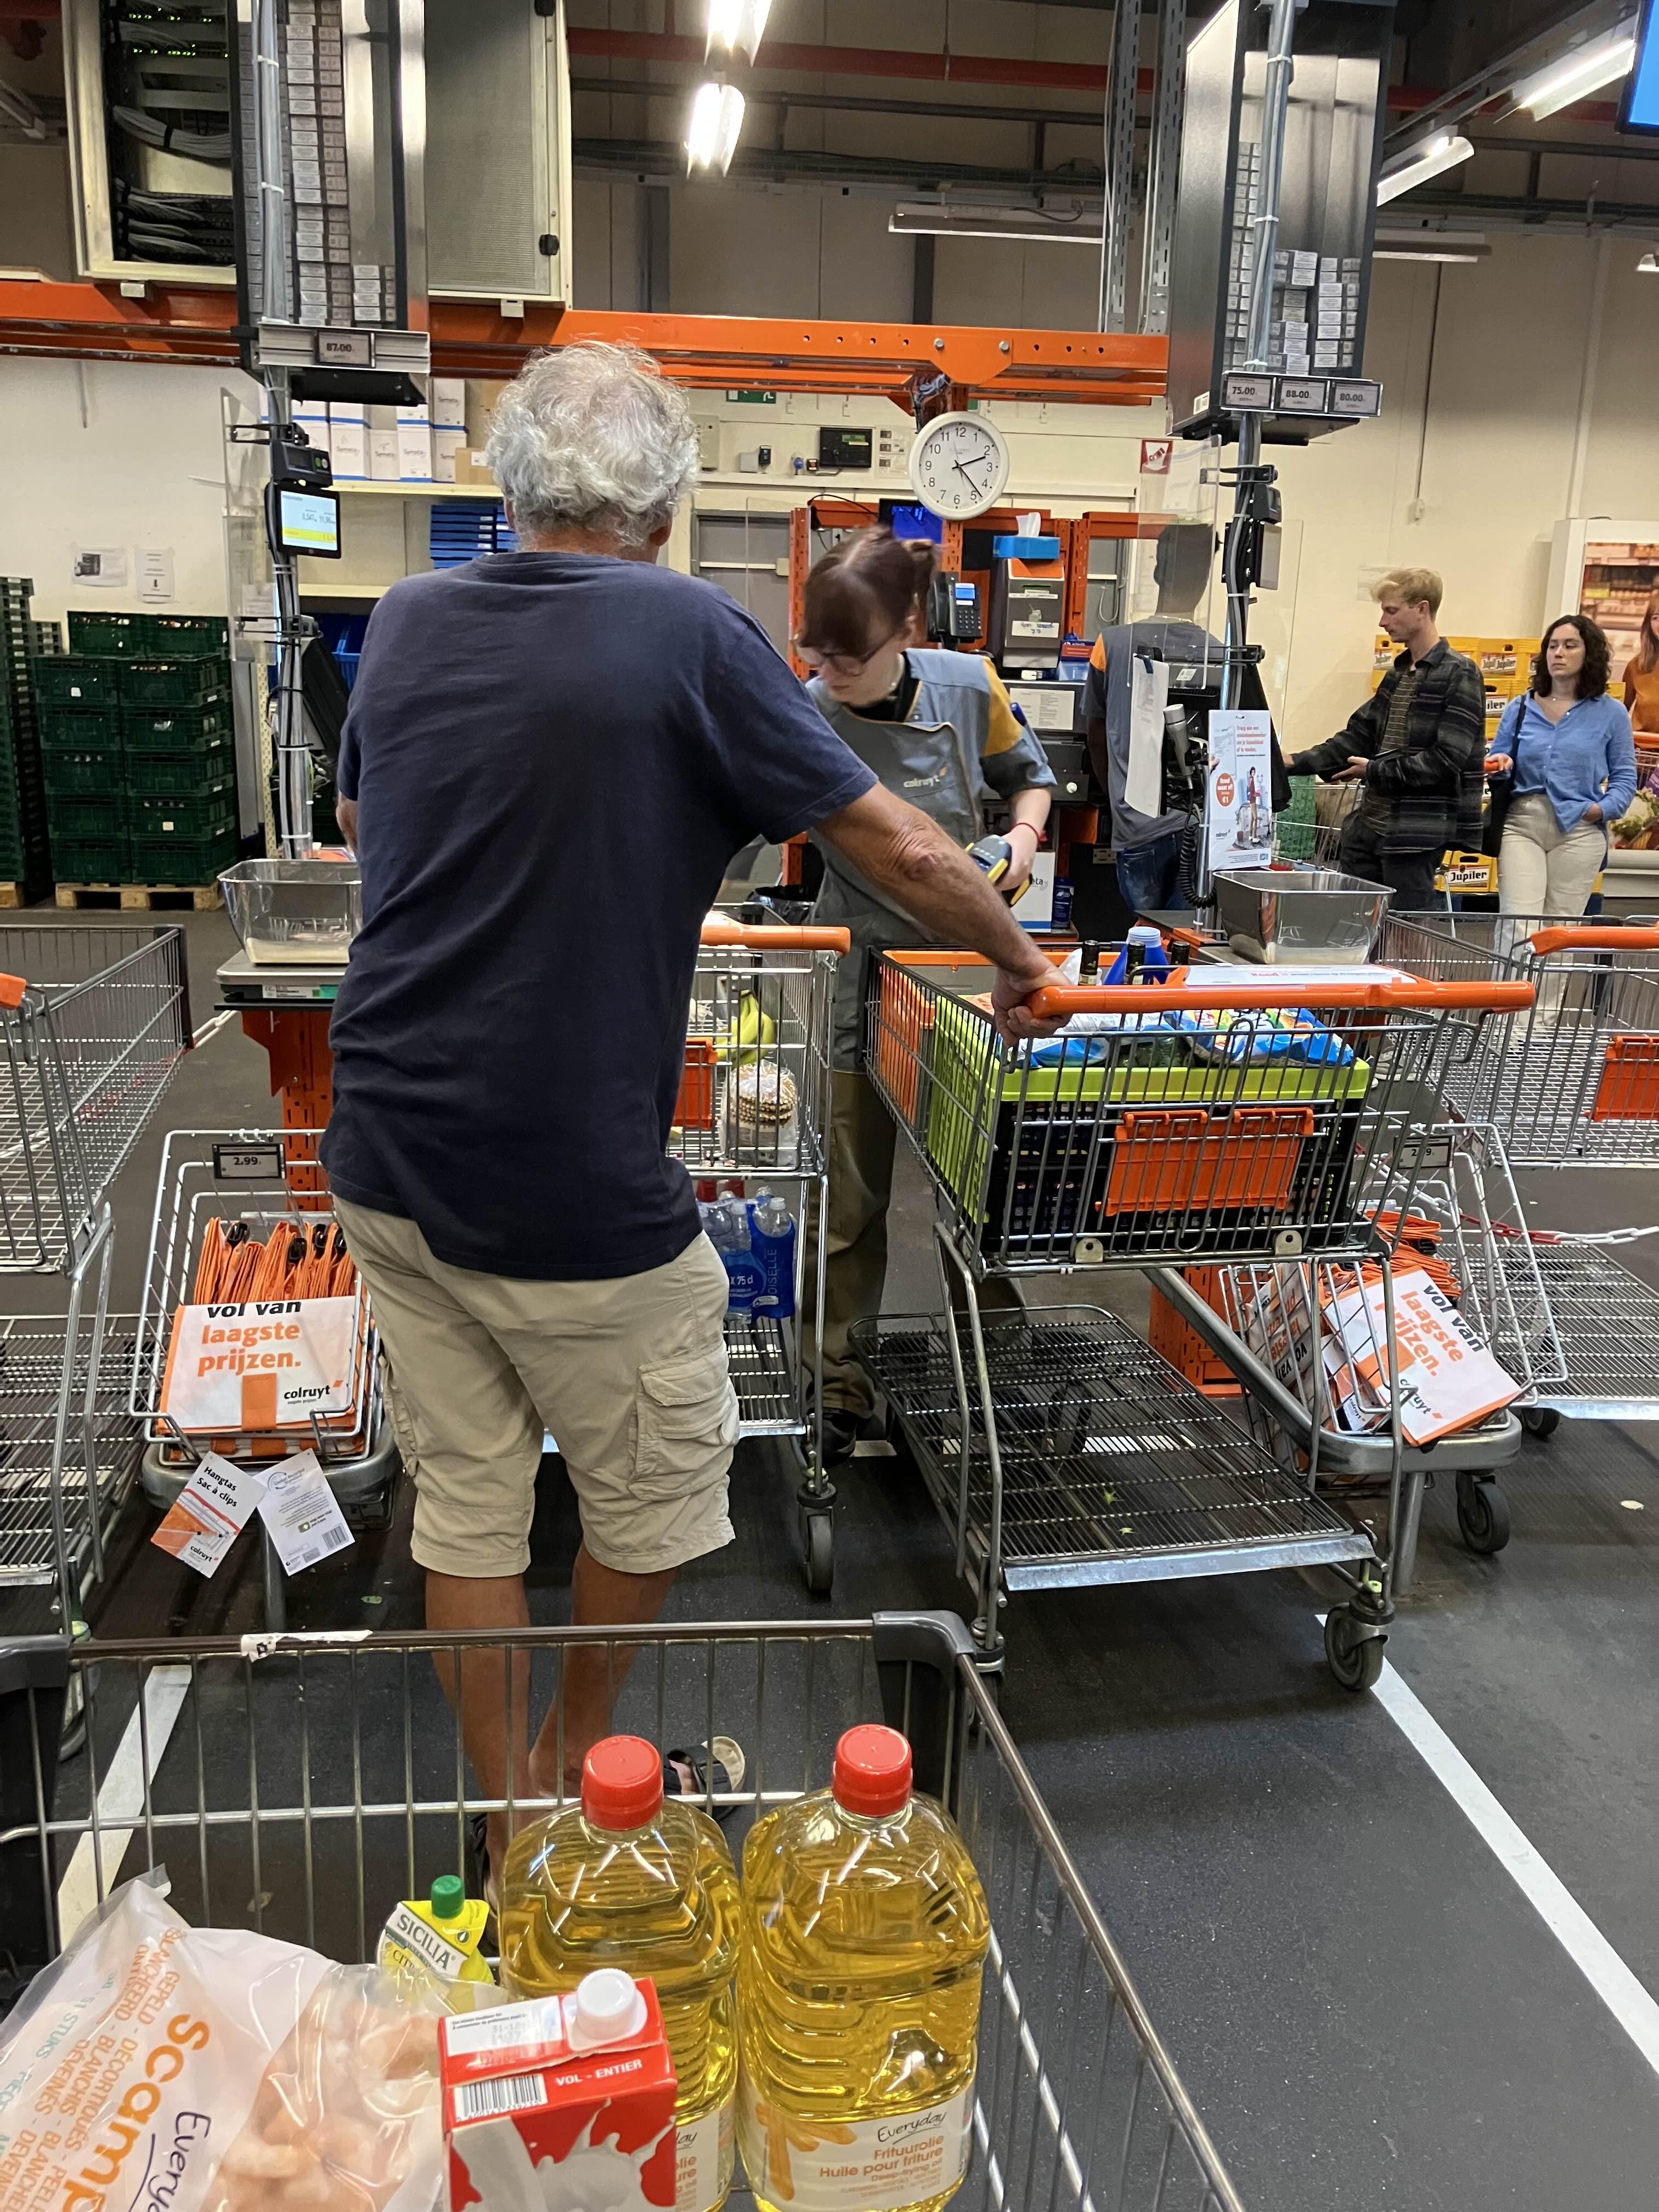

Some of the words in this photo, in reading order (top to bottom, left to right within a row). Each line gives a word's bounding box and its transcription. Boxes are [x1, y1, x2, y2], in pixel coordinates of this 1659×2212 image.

[941, 431, 950, 441] 11
[955, 427, 966, 437] 12
[974, 432, 978, 442] 1
[929, 444, 941, 454] 10
[984, 445, 990, 455] 2
[925, 460, 932, 471] 9
[986, 462, 992, 472] 3
[928, 477, 935, 487] 8
[982, 478, 988, 488] 4
[940, 490, 947, 499] 7
[953, 495, 961, 504] 6
[970, 490, 977, 500] 5
[1487, 699, 1505, 710] iler
[1450, 871, 1487, 882] Jupiler
[233, 1156, 258, 1165] 2.99
[207, 1303, 246, 1318] vol
[256, 1301, 302, 1316] van
[1424, 1285, 1454, 1313] vol
[1452, 1317, 1484, 1352] van
[1401, 1291, 1463, 1361] laagste
[201, 1321, 300, 1347] laagste
[197, 1348, 302, 1377] prijzen.
[284, 1385, 330, 1400] colruyt
[204, 1466, 237, 1491] Hangtas
[196, 1477, 211, 1491] Sac
[219, 1492, 238, 1507] clips
[190, 1545, 212, 1562] colruyt
[138, 1971, 180, 2025] GEPELD
[59, 2035, 115, 2117] BLANCHIS
[555, 2073, 583, 2086] VOL
[595, 2058, 642, 2079] ENTIER
[878, 2112, 947, 2142] Everyday
[874, 2135, 944, 2160] Frituurolie
[820, 2166, 859, 2178] Huile
[863, 2160, 899, 2176] pour
[904, 2147, 944, 2166] friture
